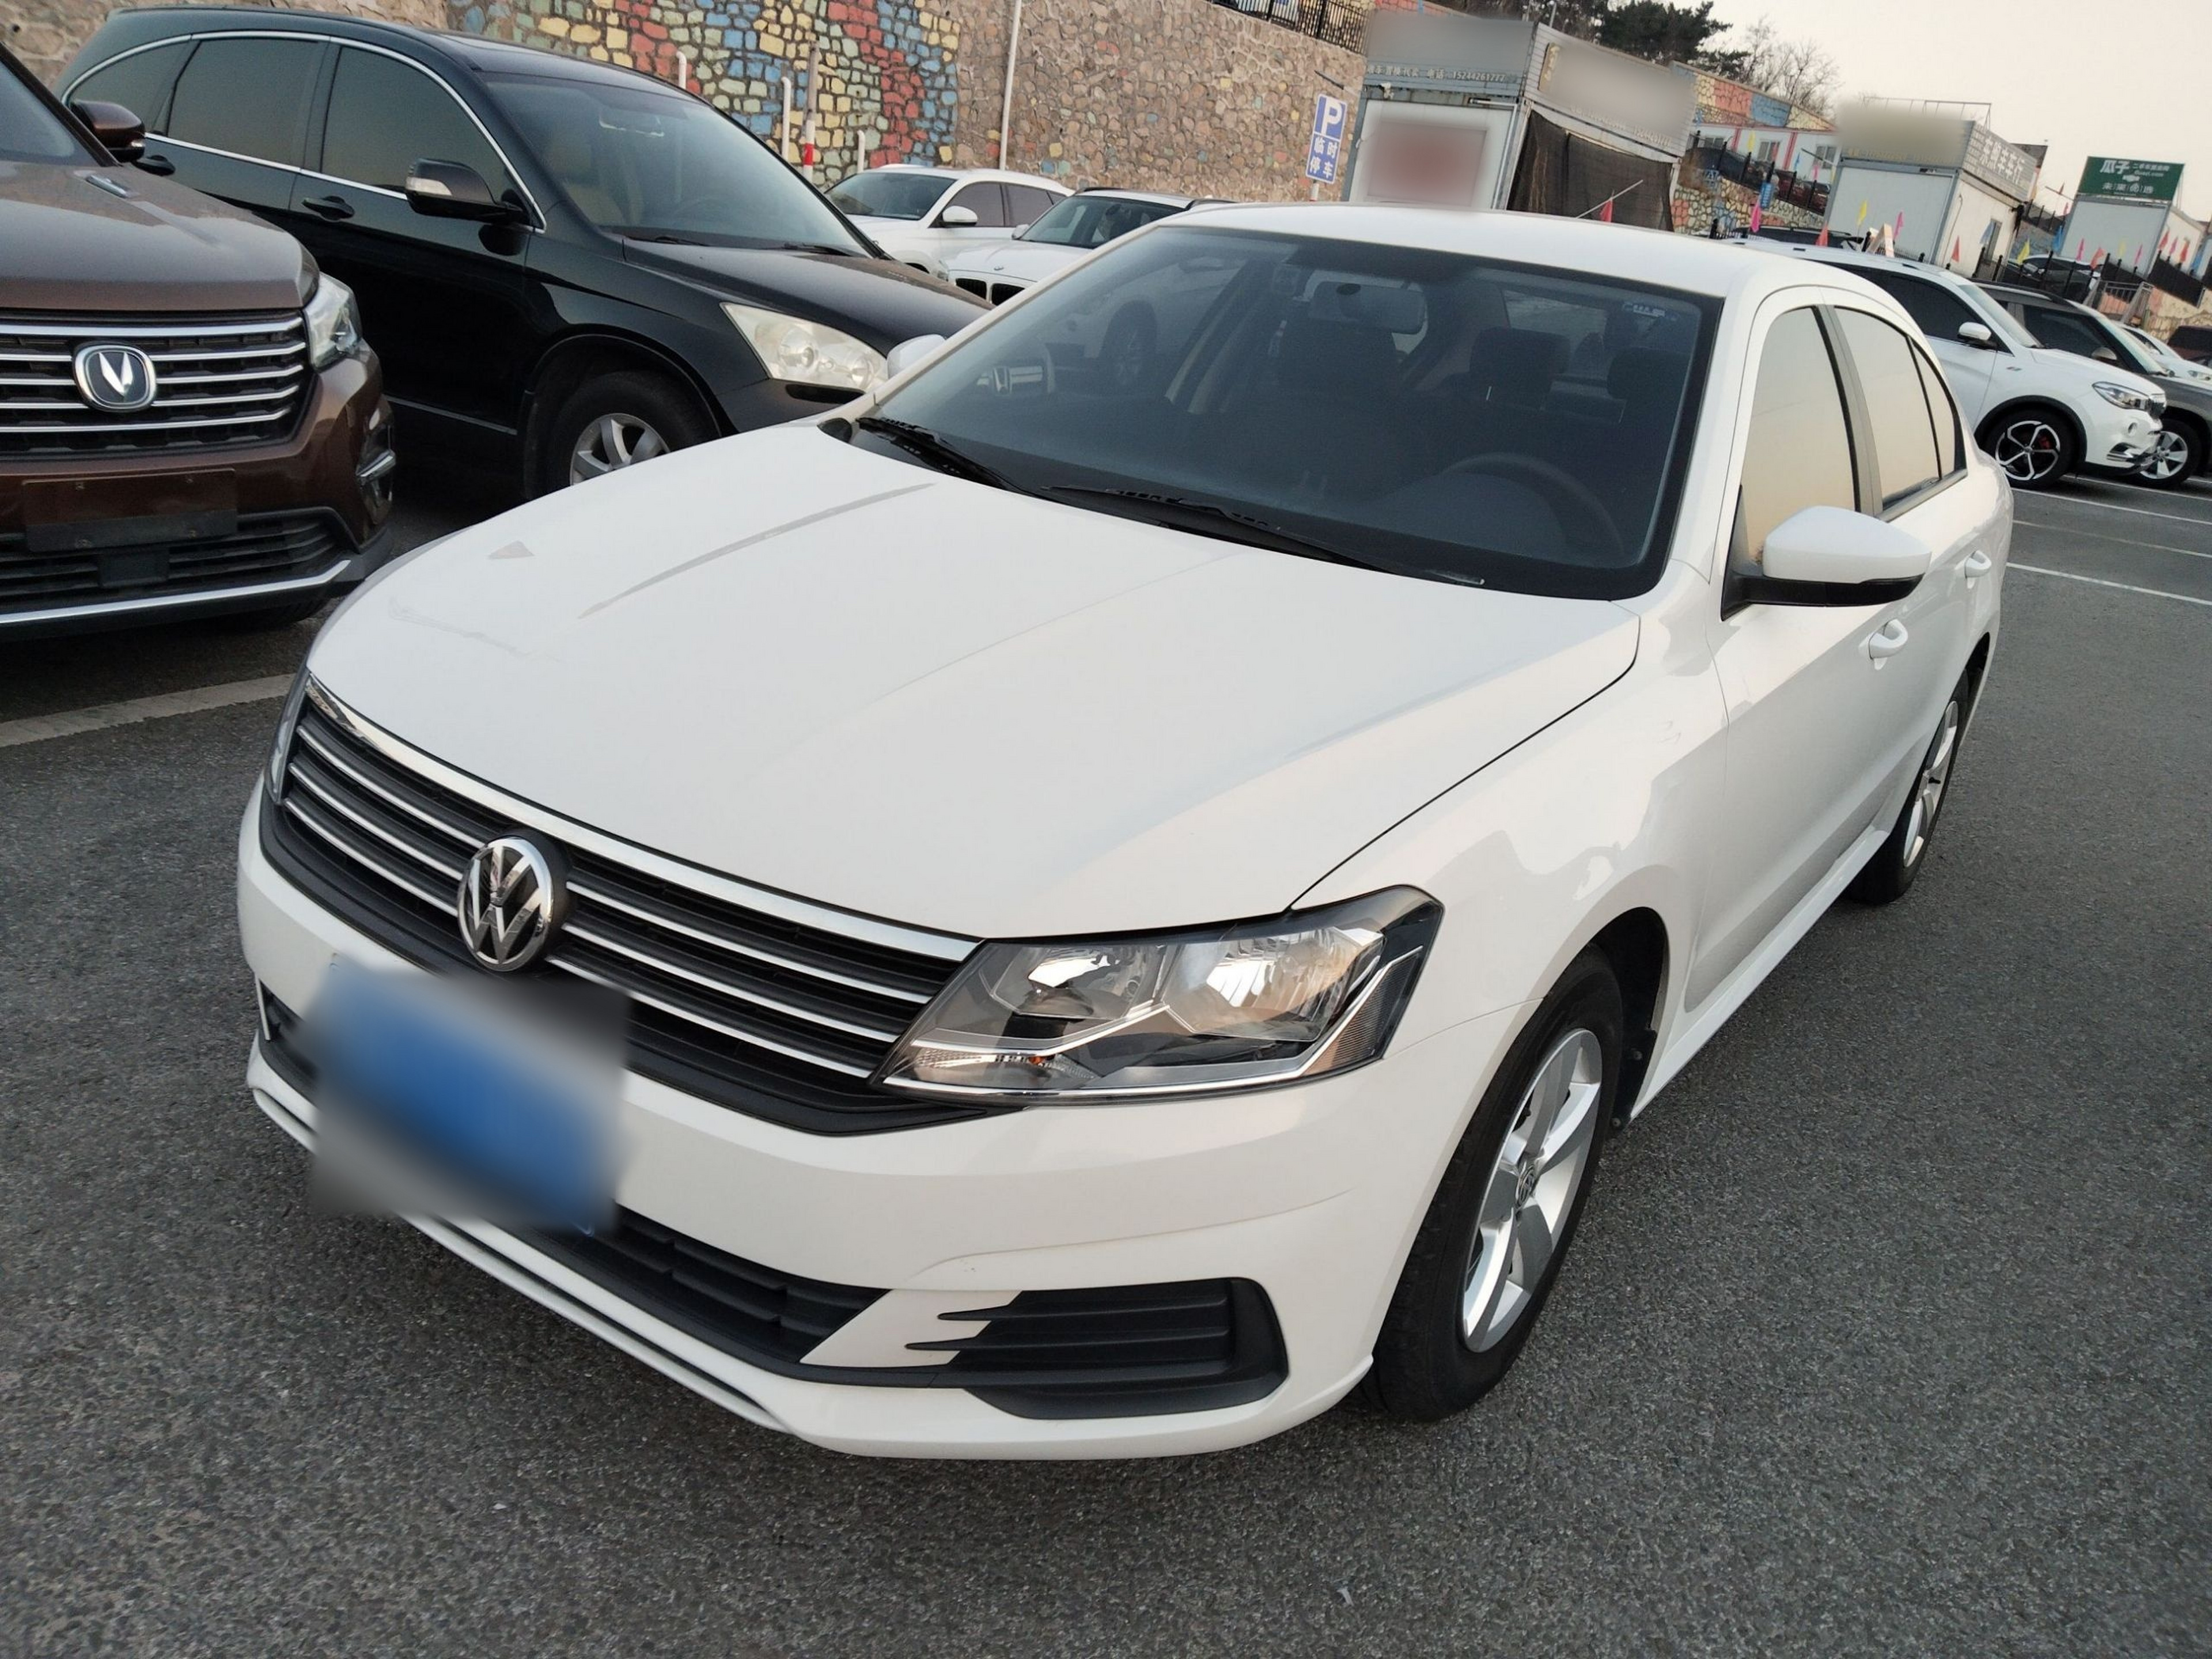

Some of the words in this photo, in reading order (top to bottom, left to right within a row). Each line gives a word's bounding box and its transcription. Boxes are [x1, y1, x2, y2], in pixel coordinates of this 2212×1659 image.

[1320, 97, 1342, 136] P
[1314, 137, 1338, 159] 临时
[1309, 156, 1334, 179] 停车
[2100, 159, 2130, 174] 瓜子
